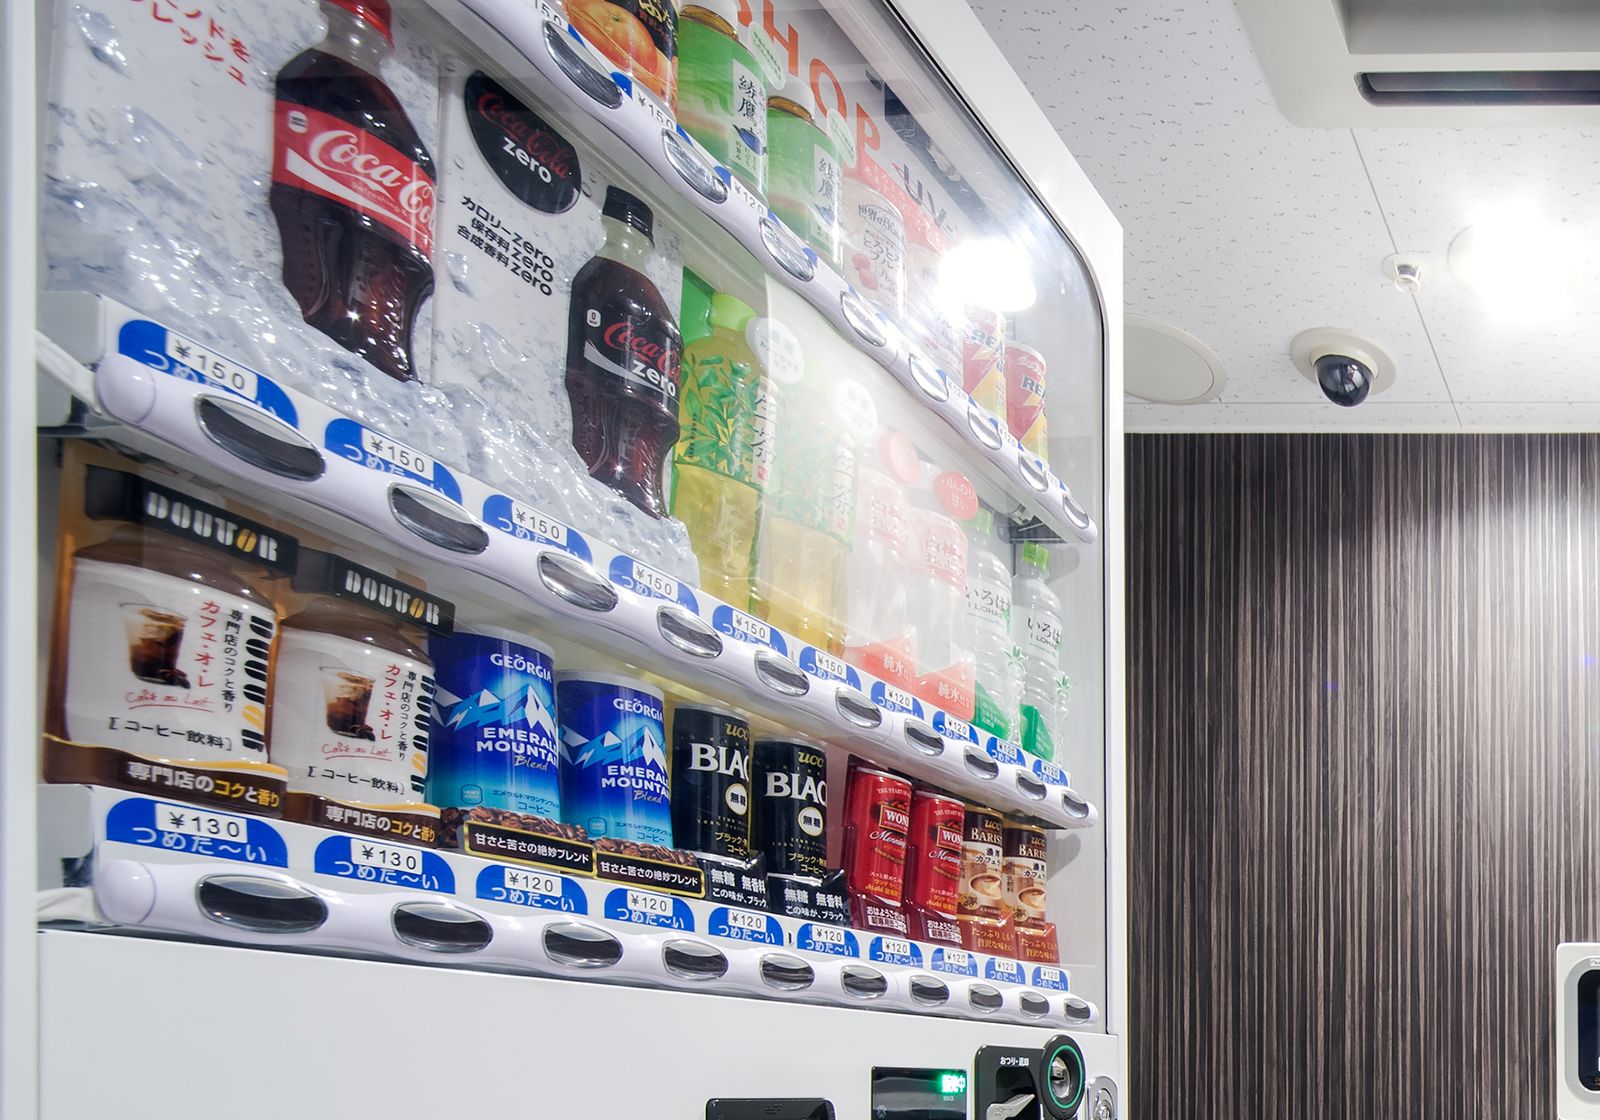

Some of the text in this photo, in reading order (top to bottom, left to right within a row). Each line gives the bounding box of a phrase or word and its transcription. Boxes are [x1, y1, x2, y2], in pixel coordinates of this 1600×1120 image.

[502, 136, 552, 184] zero
[174, 339, 246, 391] ¥150
[632, 359, 677, 397] zero
[369, 436, 425, 473] ¥150
[147, 490, 278, 563] DOUTOR
[515, 508, 561, 541] ¥150
[635, 565, 674, 597] ¥150
[345, 569, 441, 627] DOUTOR
[735, 613, 767, 640] ¥150
[817, 655, 844, 676] ¥150
[513, 754, 549, 773] Blend
[128, 760, 281, 810] 専門店のコクと香り
[633, 789, 662, 804] Blend
[169, 812, 240, 839] ¥130
[325, 805, 436, 844] 専門店のコクと香り
[361, 844, 417, 871] ¥130
[473, 831, 590, 864] 甘さと苦さの絶妙ブレンド
[508, 870, 554, 894] ¥120
[599, 860, 699, 888] 甘さと苦さの絶妙ブレンド
[711, 867, 735, 888] 無糖
[630, 892, 668, 913] ¥120
[730, 910, 763, 930] ¥120
